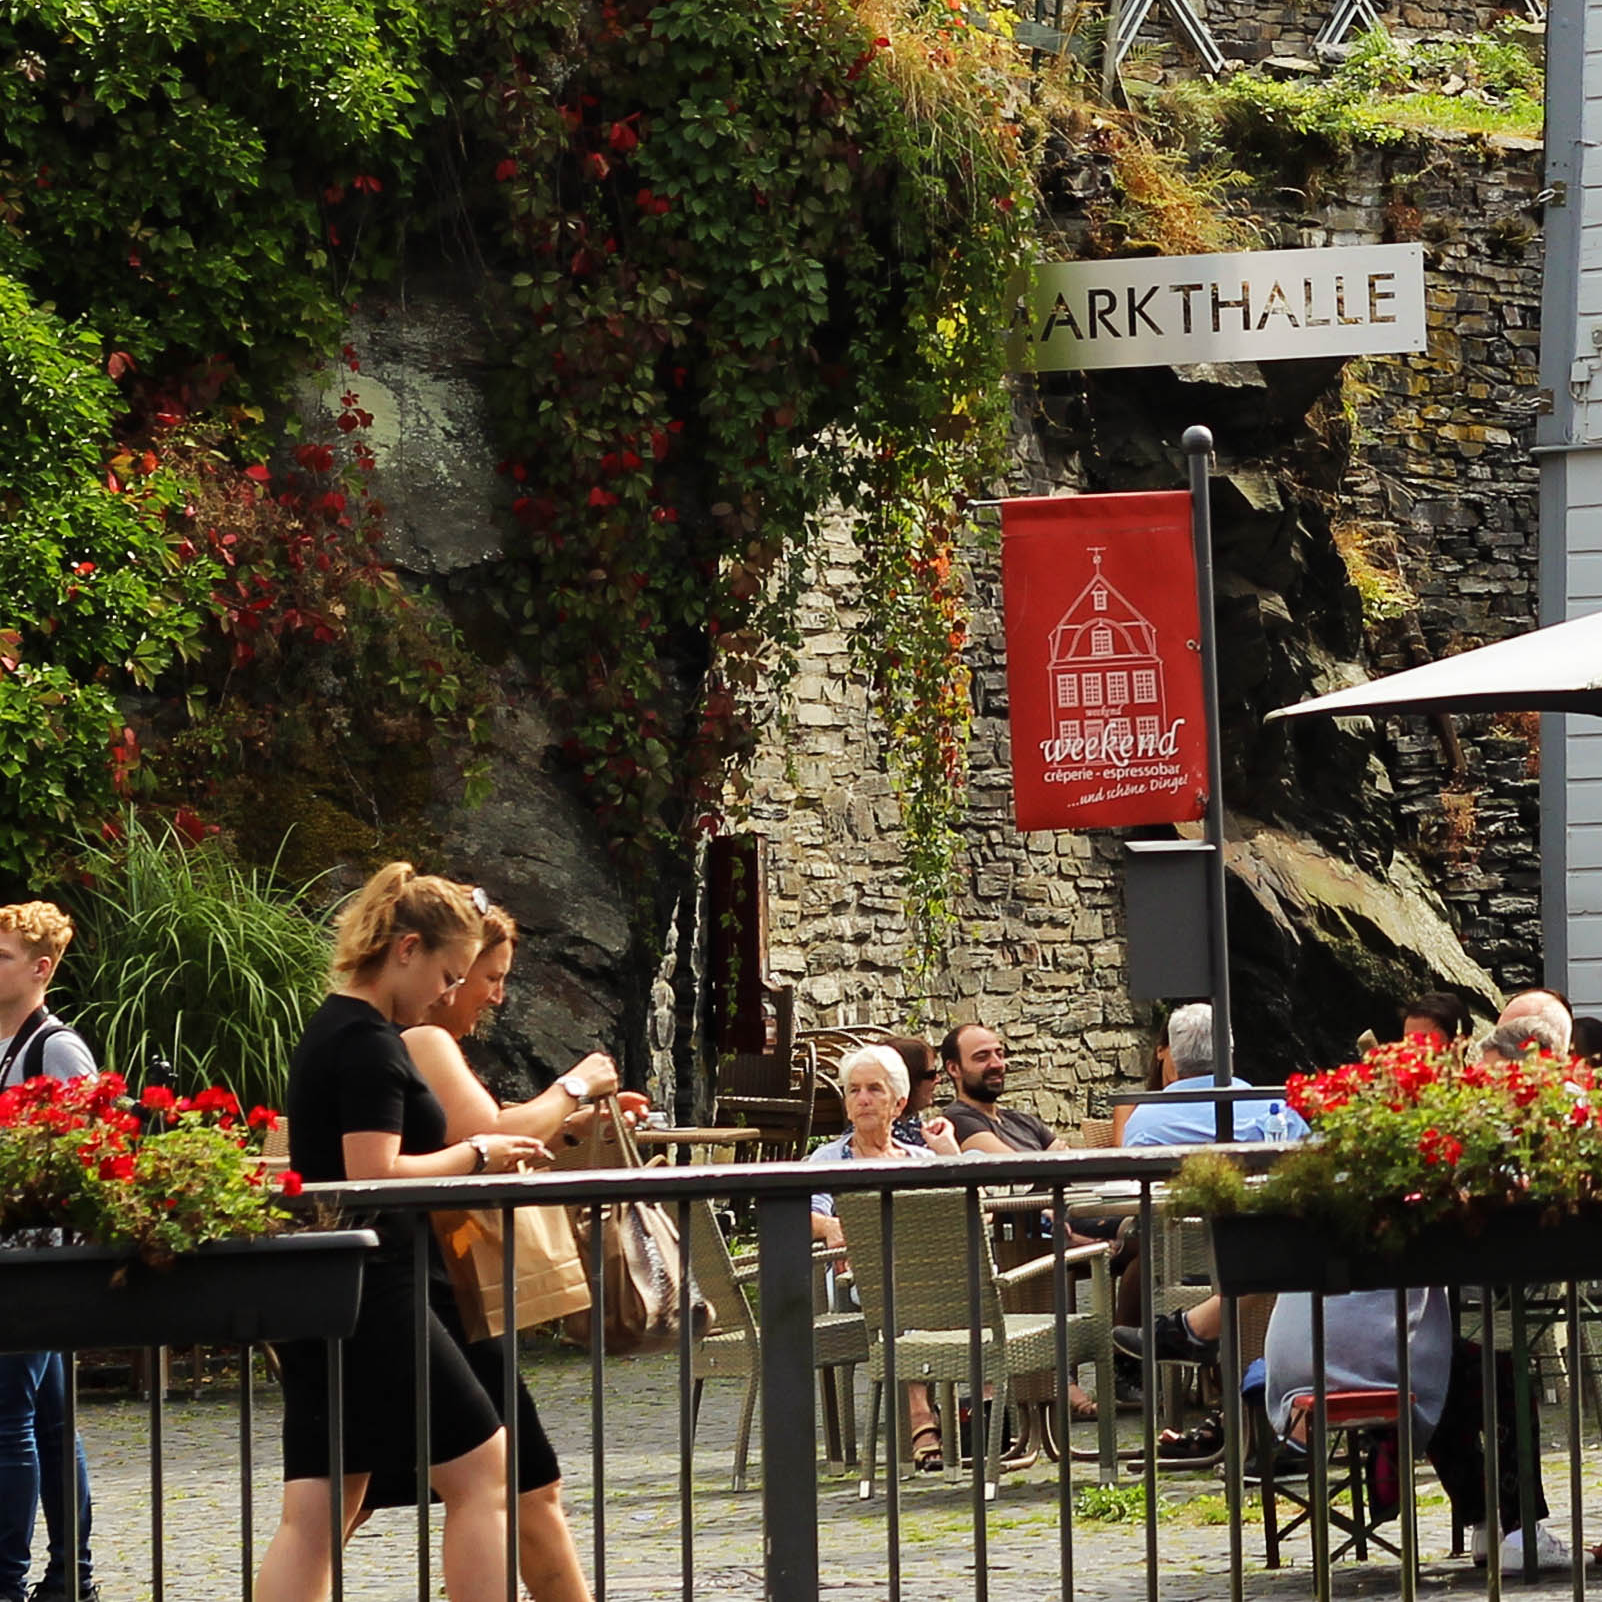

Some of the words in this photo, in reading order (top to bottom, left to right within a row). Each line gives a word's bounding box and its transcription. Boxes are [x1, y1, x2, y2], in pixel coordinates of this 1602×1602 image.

[1039, 717, 1186, 767] weekend
[1043, 767, 1094, 784] crêperie
[1102, 762, 1181, 781] espressobar
[1106, 782, 1148, 800] schöne
[1149, 773, 1188, 795] Dinge!
